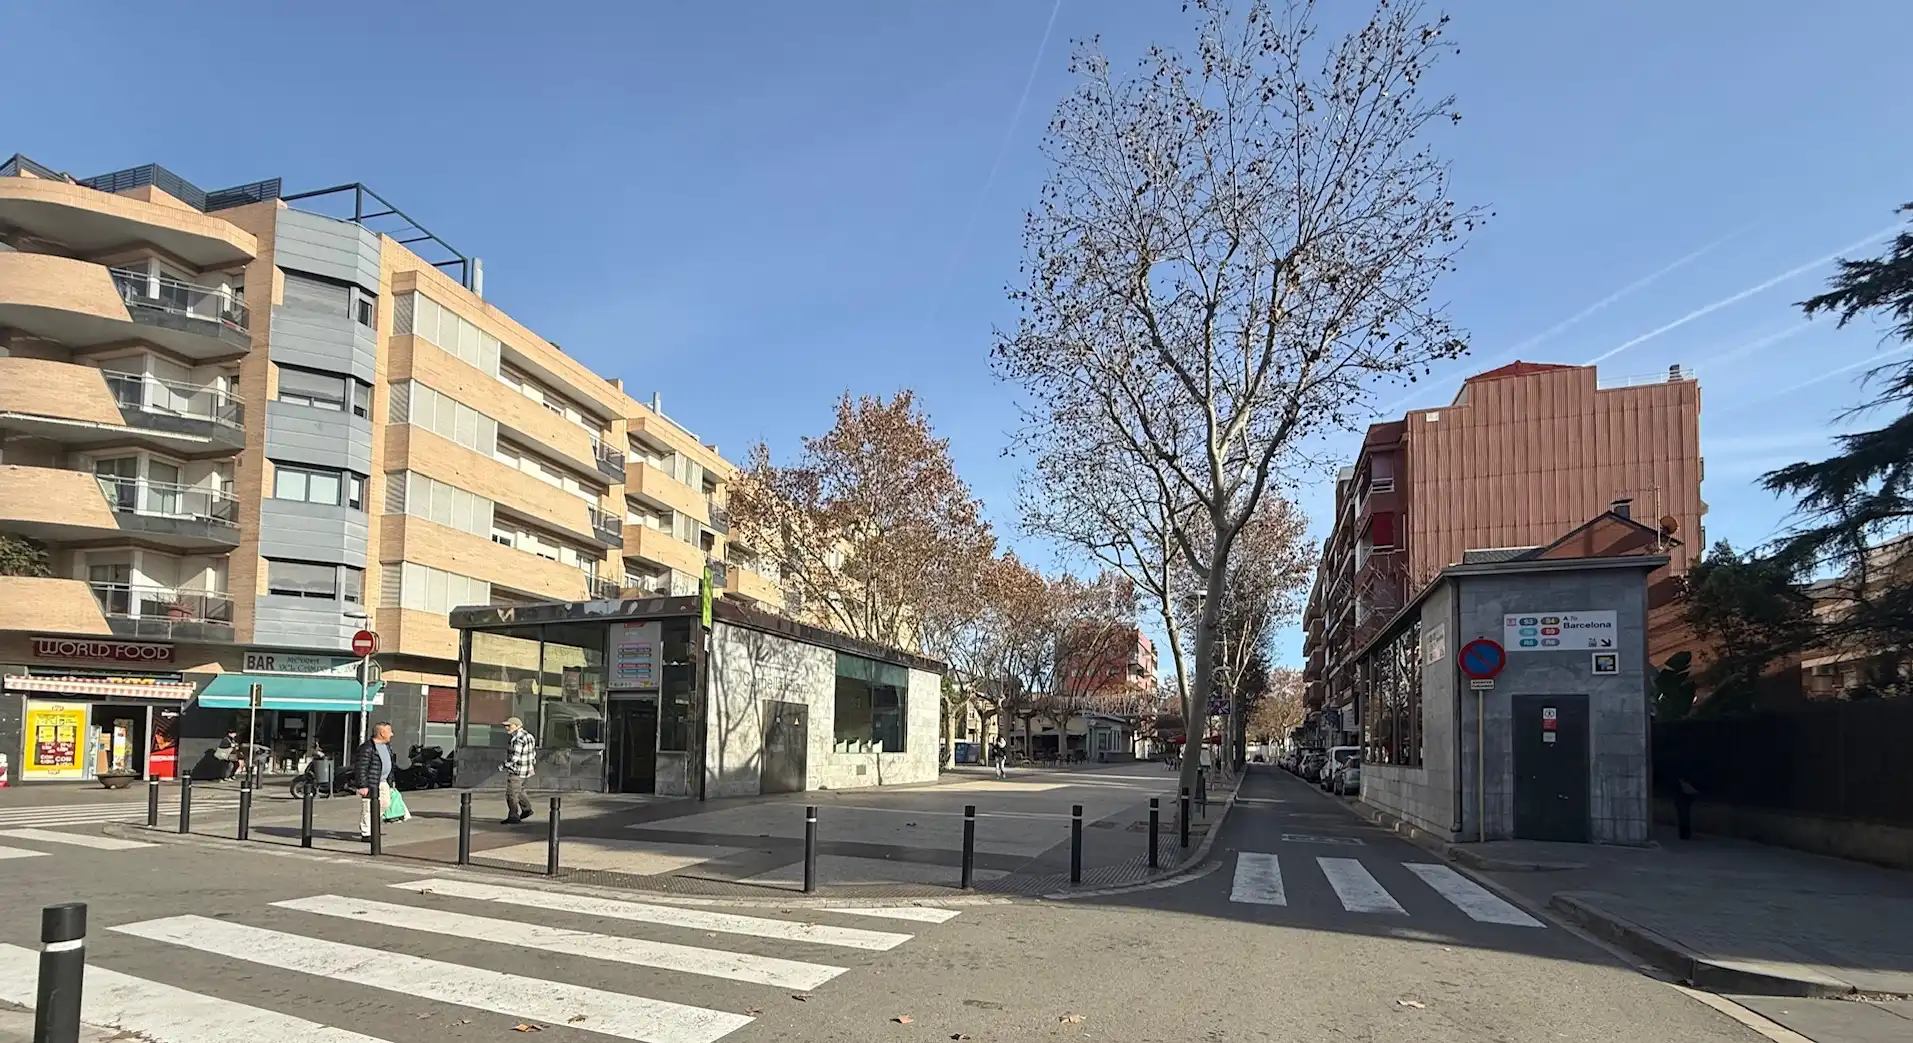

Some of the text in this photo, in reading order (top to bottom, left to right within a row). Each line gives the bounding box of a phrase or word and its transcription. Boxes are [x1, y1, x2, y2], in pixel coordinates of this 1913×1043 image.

[1563, 621, 1612, 629] Barcelona
[39, 640, 169, 659] WORLD FOOD
[247, 656, 275, 670] BAR
